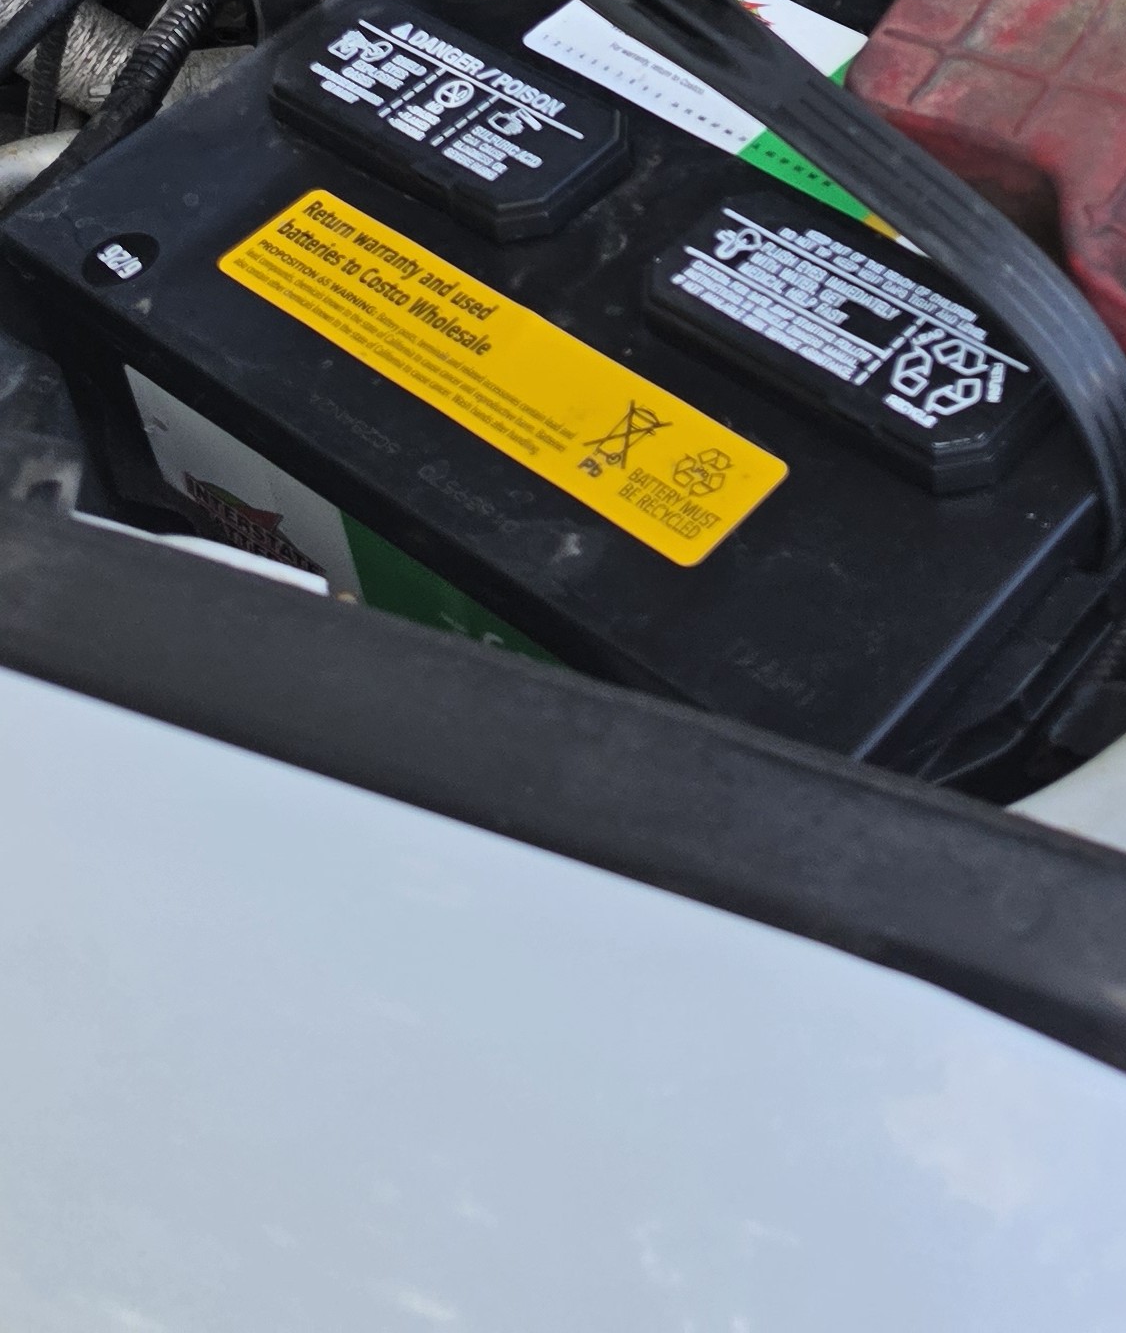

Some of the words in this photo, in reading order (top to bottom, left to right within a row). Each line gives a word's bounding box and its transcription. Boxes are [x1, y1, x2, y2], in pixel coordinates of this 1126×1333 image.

[277, 219, 344, 265] batteries
[340, 259, 361, 275] to
[359, 268, 409, 305] Costco
[408, 298, 490, 355] Wholesale
[303, 200, 355, 237] Return
[353, 232, 422, 279] warranty
[418, 272, 459, 296] and
[450, 292, 498, 320] used
[577, 457, 602, 477] Pb
[628, 467, 684, 505] BATTERY
[679, 501, 720, 528] MUST
[617, 482, 640, 501] BE
[635, 494, 700, 539] RECYCLED
